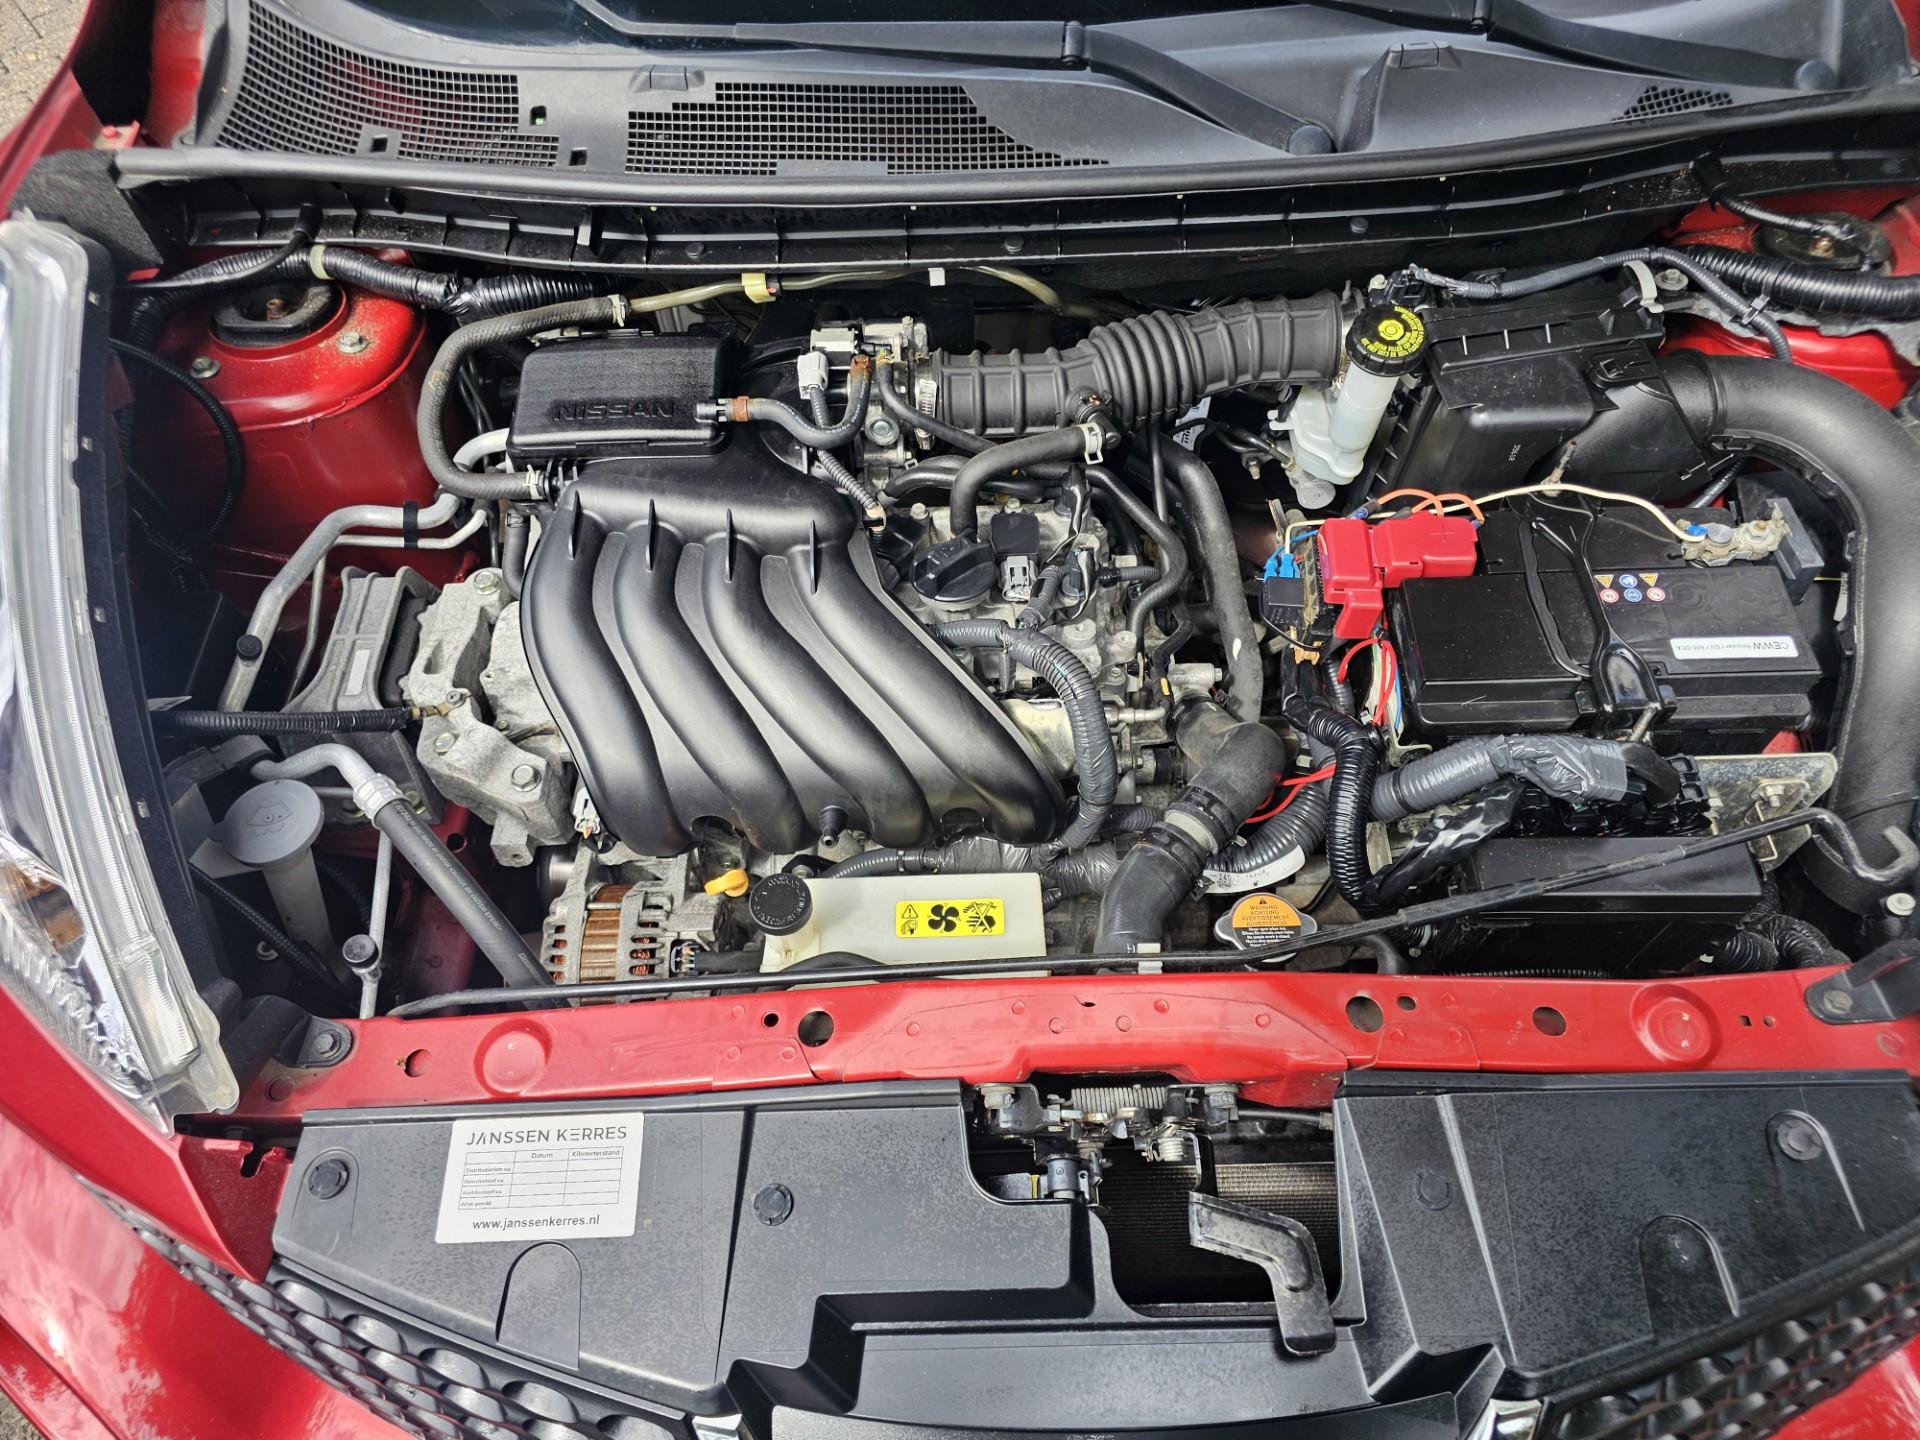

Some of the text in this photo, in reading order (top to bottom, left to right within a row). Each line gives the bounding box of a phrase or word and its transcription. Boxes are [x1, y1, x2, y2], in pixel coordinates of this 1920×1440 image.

[552, 401, 674, 421] NISSAN
[466, 1126, 627, 1146] JANSSEN KERRES
[571, 1149, 620, 1158] Kilometerstand
[472, 1213, 600, 1231] www.janssenkerres.nl
